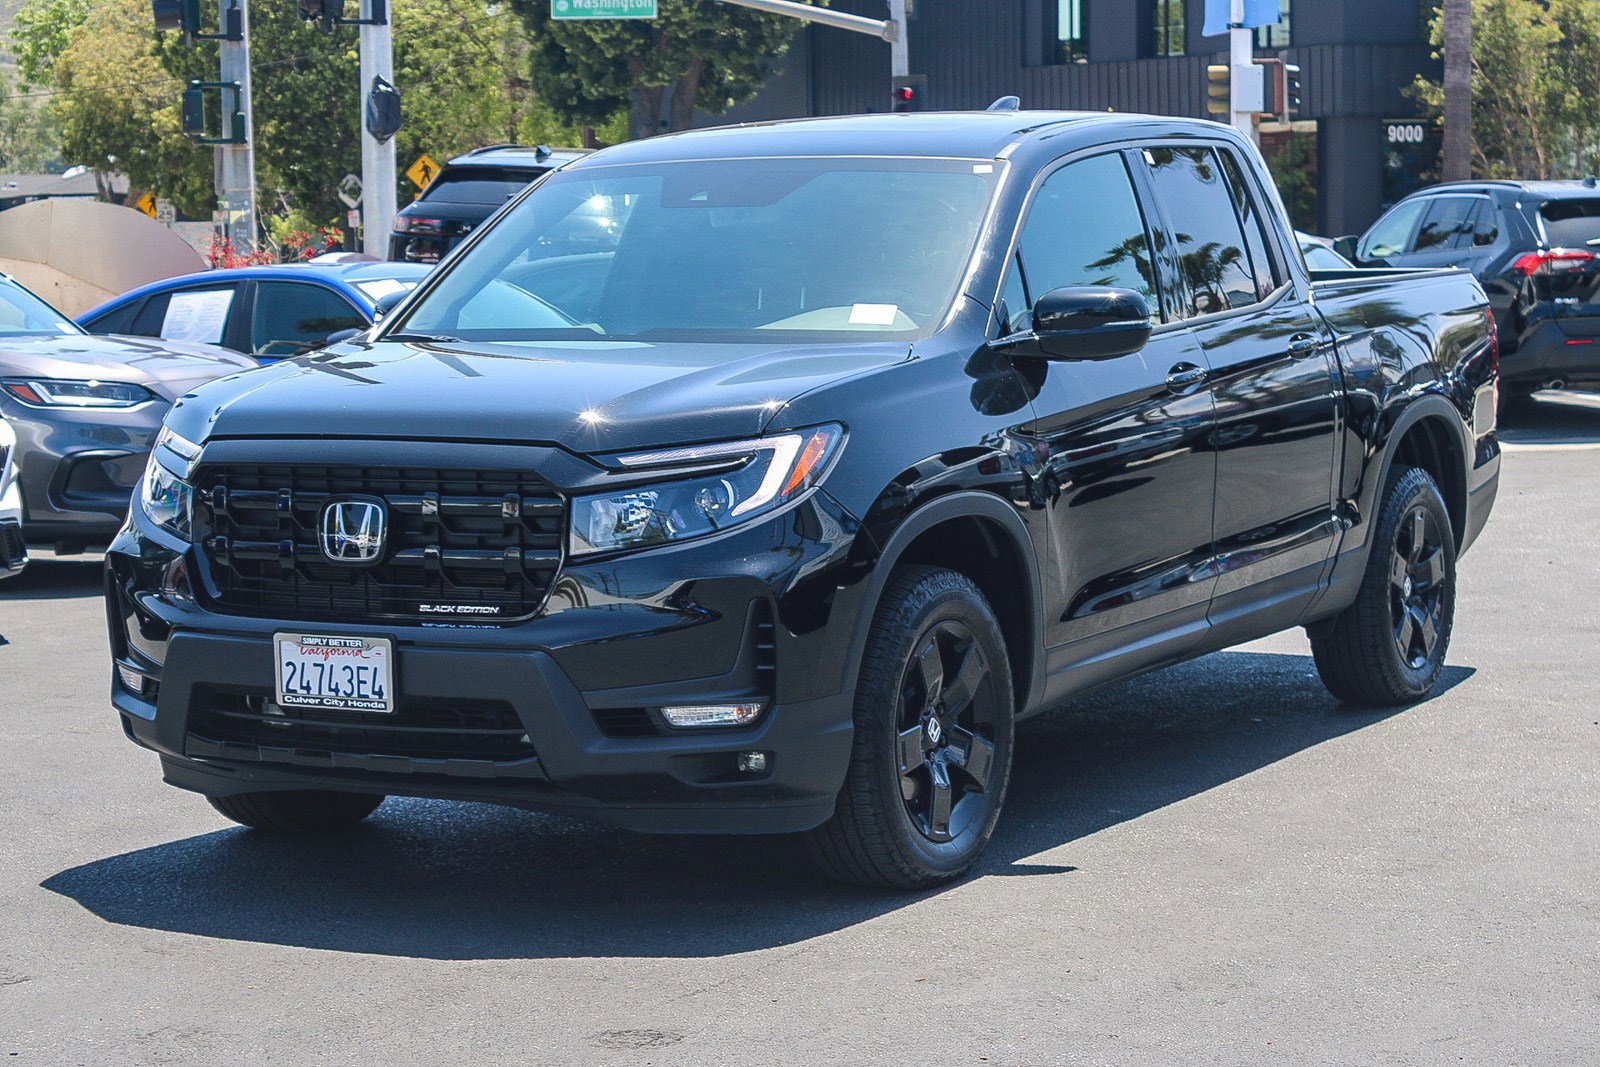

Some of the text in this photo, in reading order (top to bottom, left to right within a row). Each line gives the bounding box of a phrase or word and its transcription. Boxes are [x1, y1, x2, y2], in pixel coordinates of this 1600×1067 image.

[572, 0, 652, 12] Washington
[1387, 125, 1424, 142] 9000
[159, 209, 174, 221] 25
[419, 604, 456, 613] BLACK
[302, 637, 362, 647] SIMPLY BETTER
[300, 646, 370, 661] California
[285, 661, 385, 699] 24743E4
[284, 695, 385, 709] Culver City Honda
